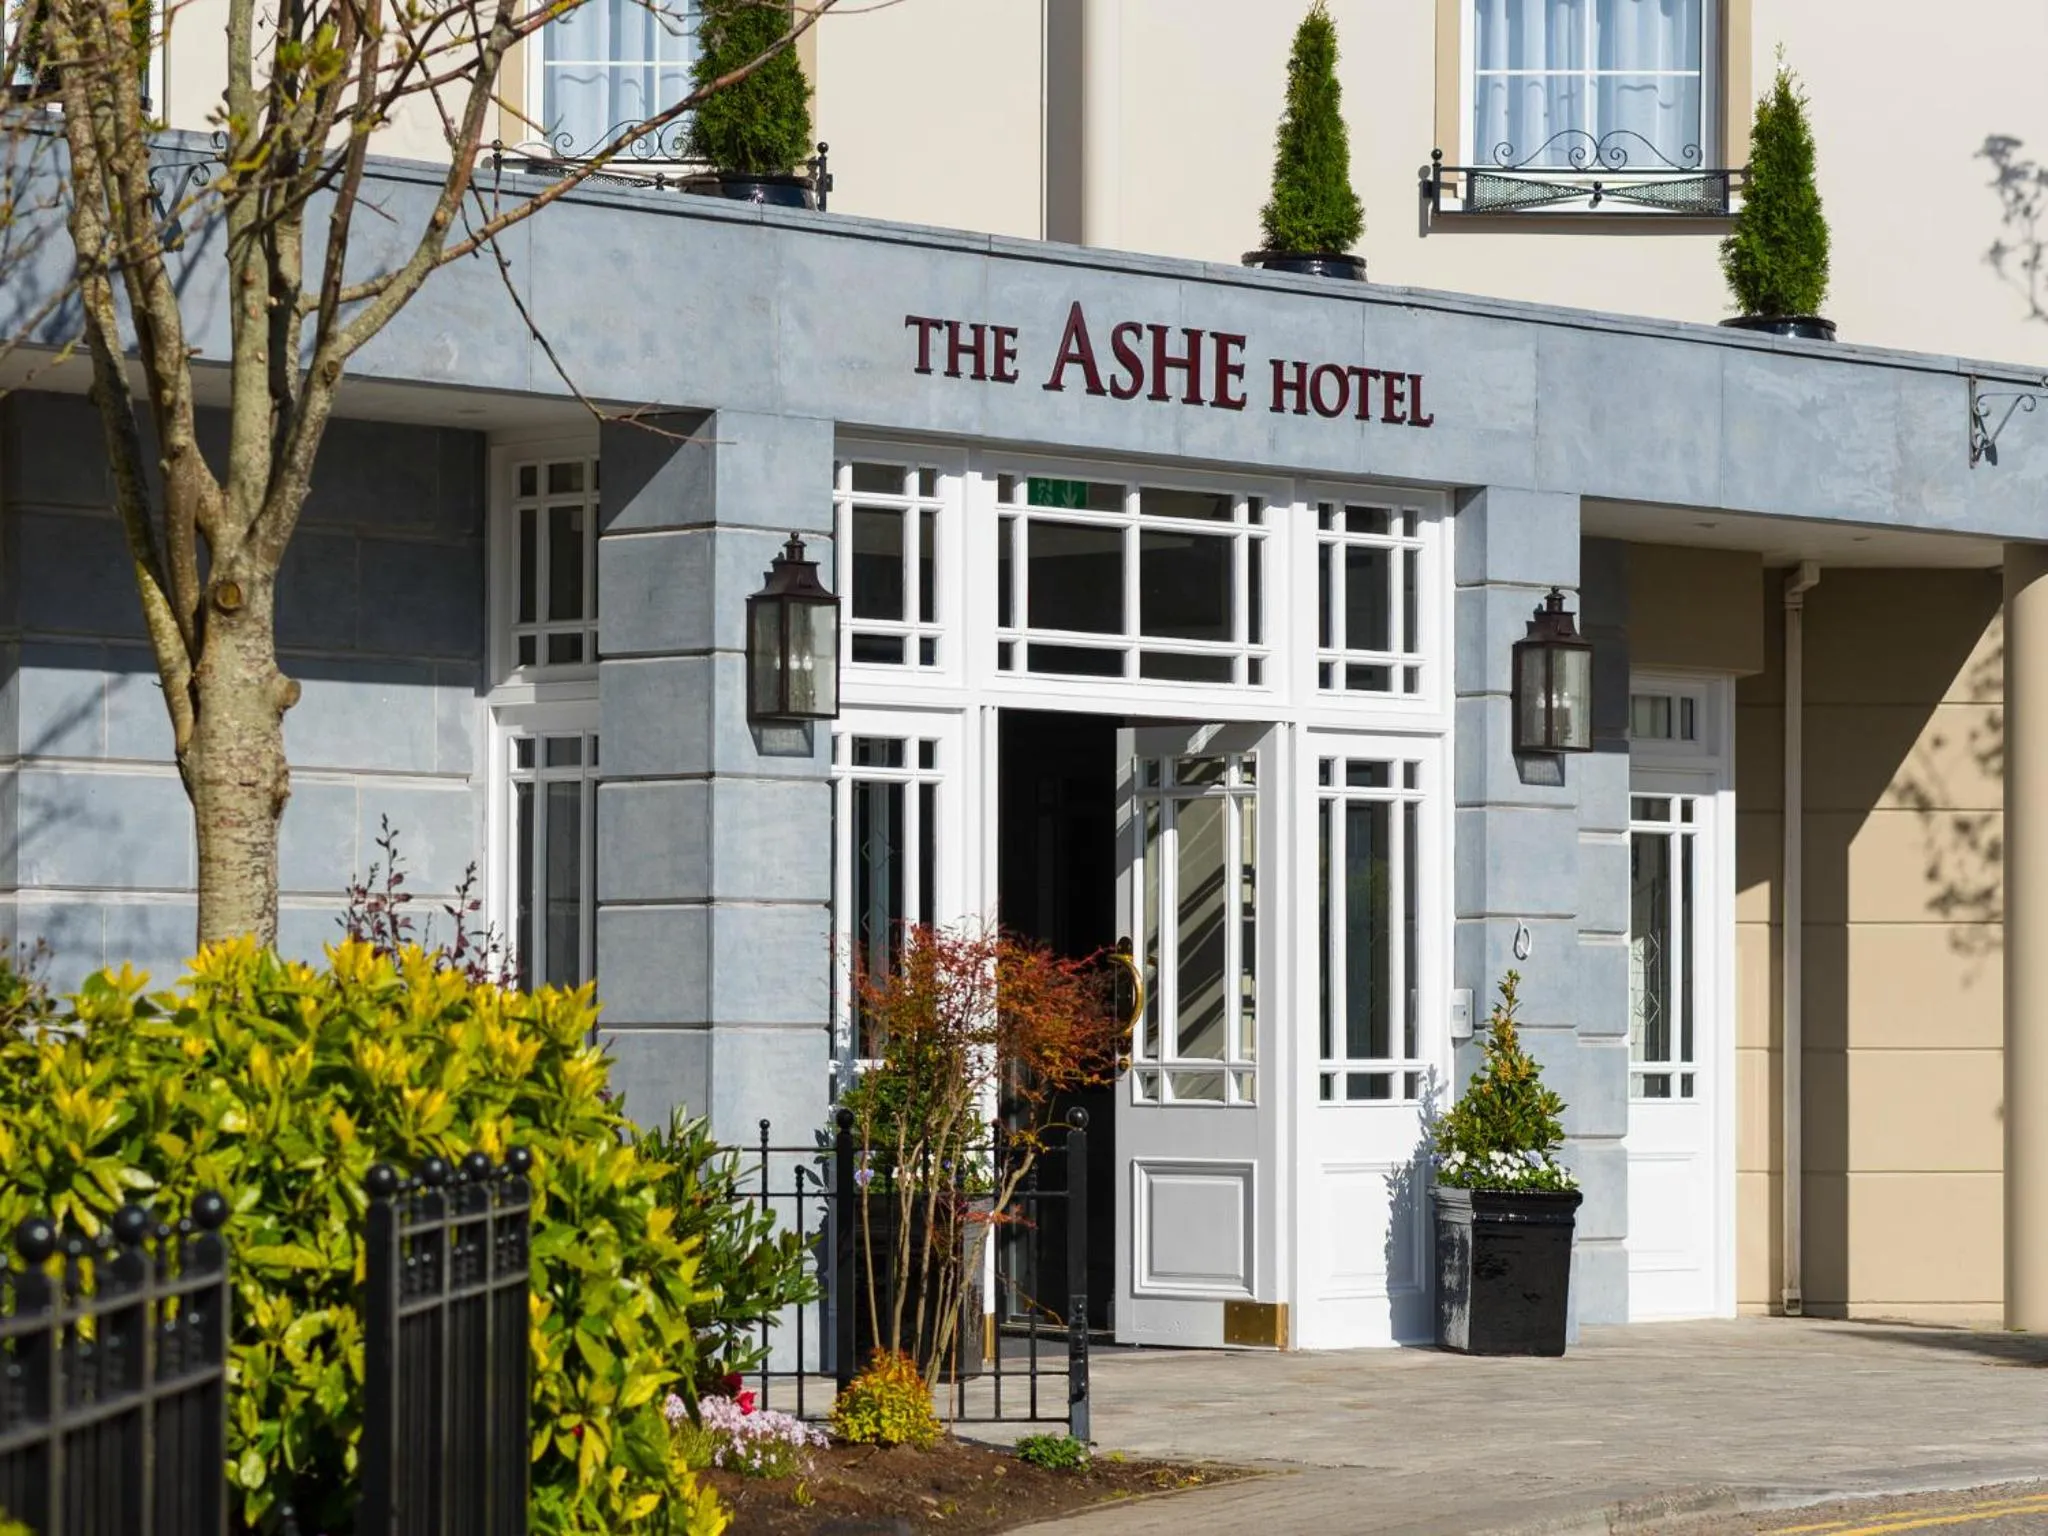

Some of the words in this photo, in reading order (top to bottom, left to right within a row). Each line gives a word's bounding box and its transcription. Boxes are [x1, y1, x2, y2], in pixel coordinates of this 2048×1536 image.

[905, 314, 1019, 384] THE
[1042, 300, 1247, 411] ASHE
[1269, 358, 1435, 428] HOTEL
